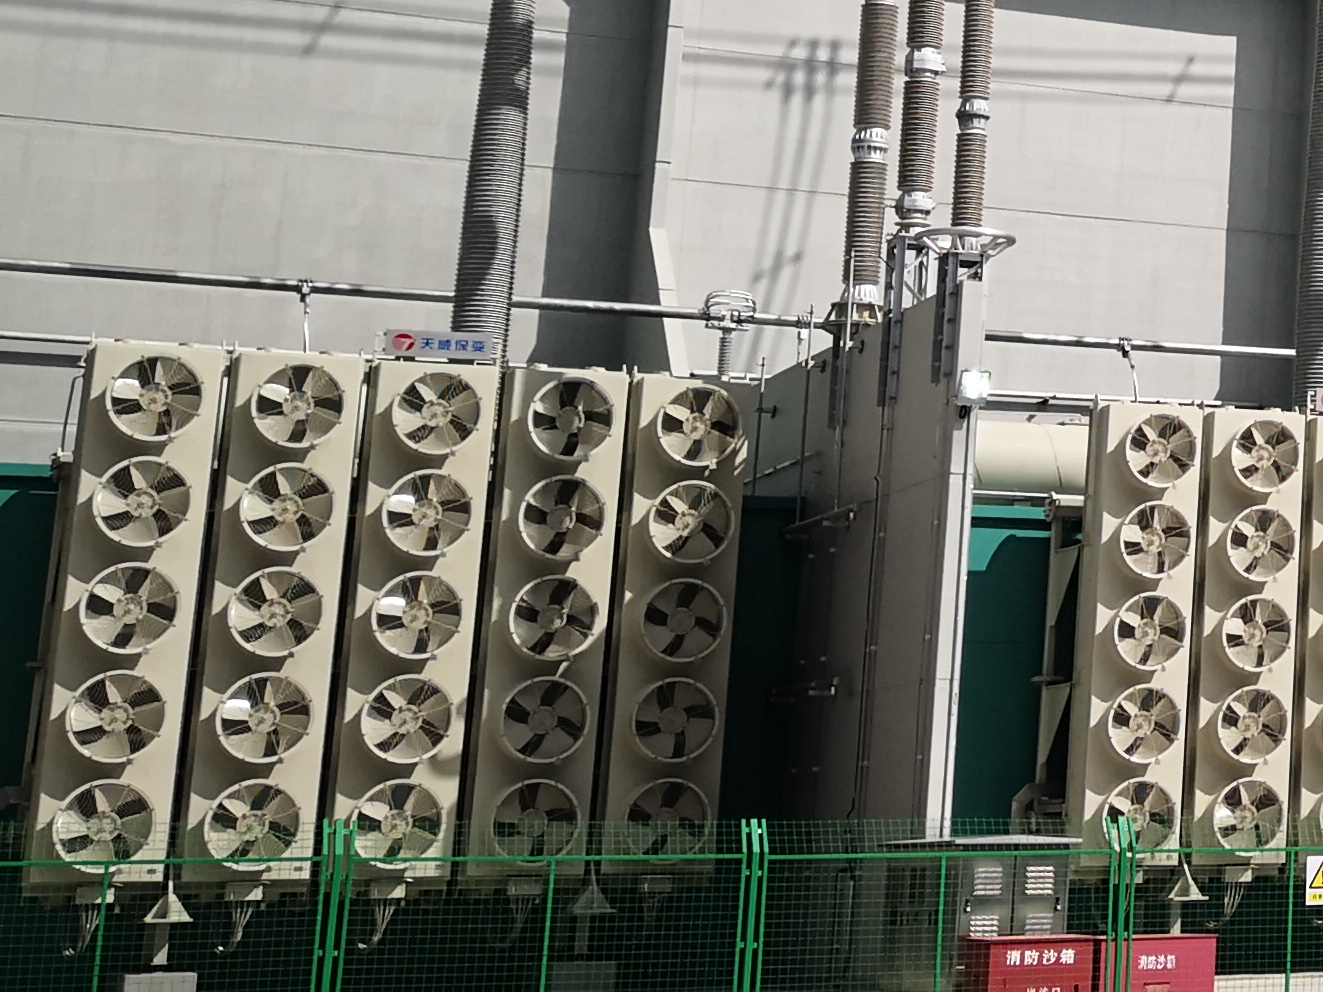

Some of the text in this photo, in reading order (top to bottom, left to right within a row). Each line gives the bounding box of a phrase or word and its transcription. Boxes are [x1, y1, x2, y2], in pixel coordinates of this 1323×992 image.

[421, 337, 486, 352] 天威保变
[1005, 949, 1076, 965] 消防沙箱
